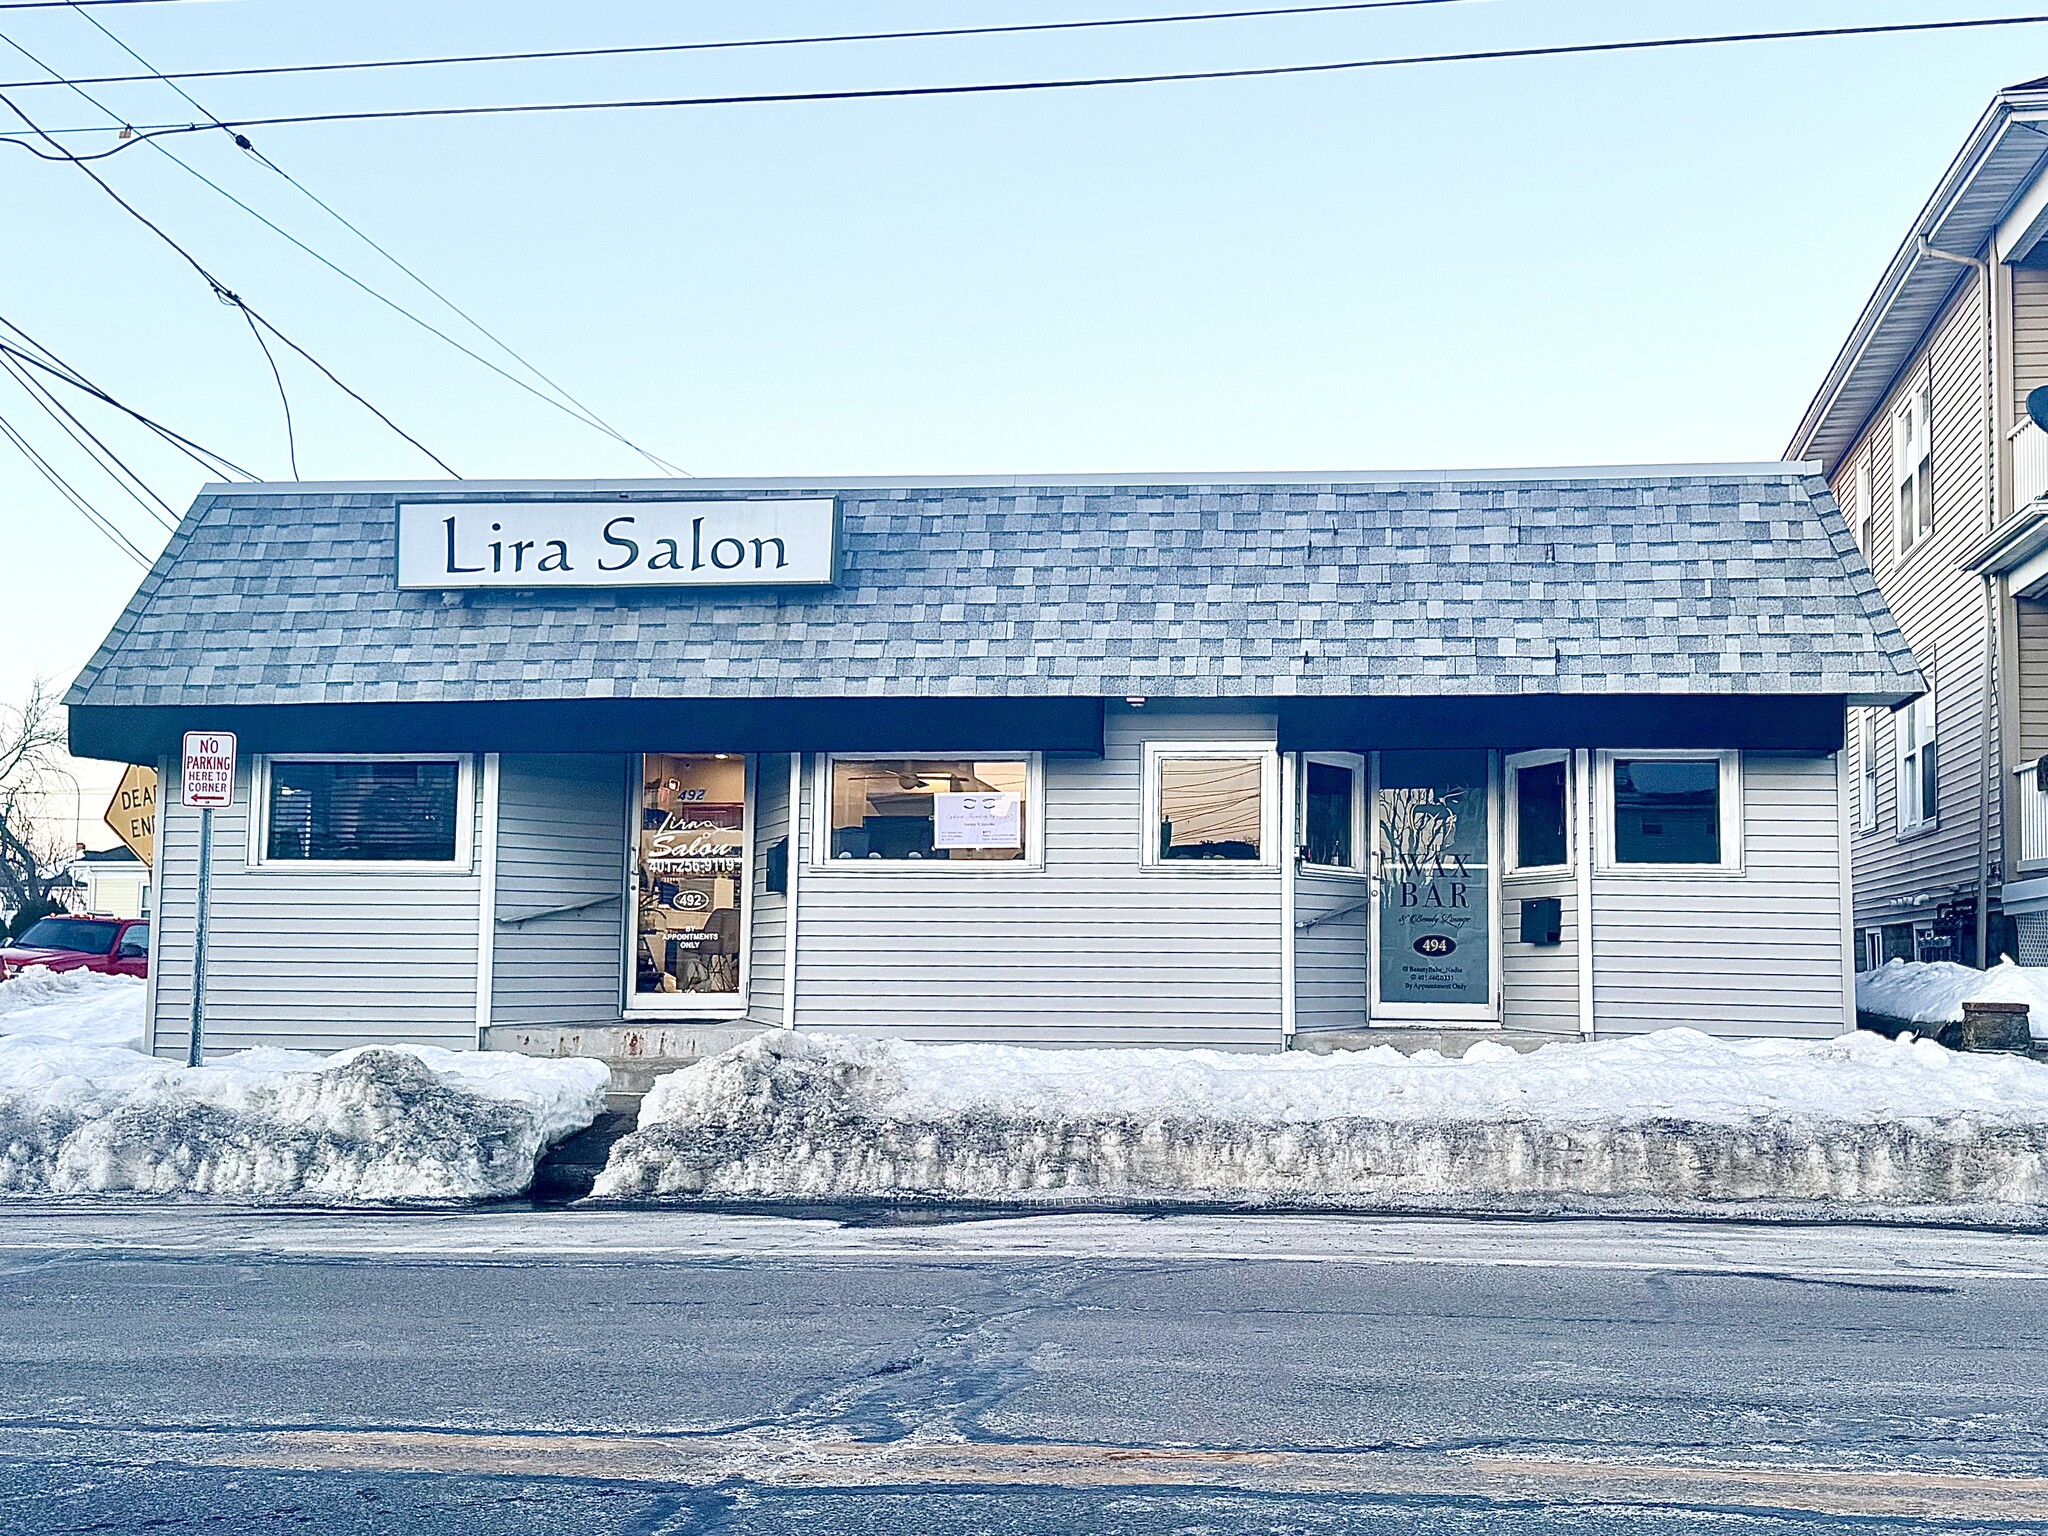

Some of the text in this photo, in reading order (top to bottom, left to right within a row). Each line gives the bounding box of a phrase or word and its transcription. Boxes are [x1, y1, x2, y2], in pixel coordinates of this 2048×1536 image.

[442, 516, 789, 573] Lira Salon
[200, 739, 219, 753] NO
[186, 756, 231, 770] PARKING
[188, 771, 227, 781] HERE TO
[188, 783, 227, 792] CORNER
[677, 789, 706, 801] 492
[648, 836, 732, 857] Salon
[1399, 853, 1472, 878] WAX
[680, 894, 702, 906] 492
[1400, 881, 1470, 909] BAR
[662, 933, 719, 941] APPOINTMENTS
[680, 941, 700, 949] ONLY
[1422, 939, 1447, 952] 494
